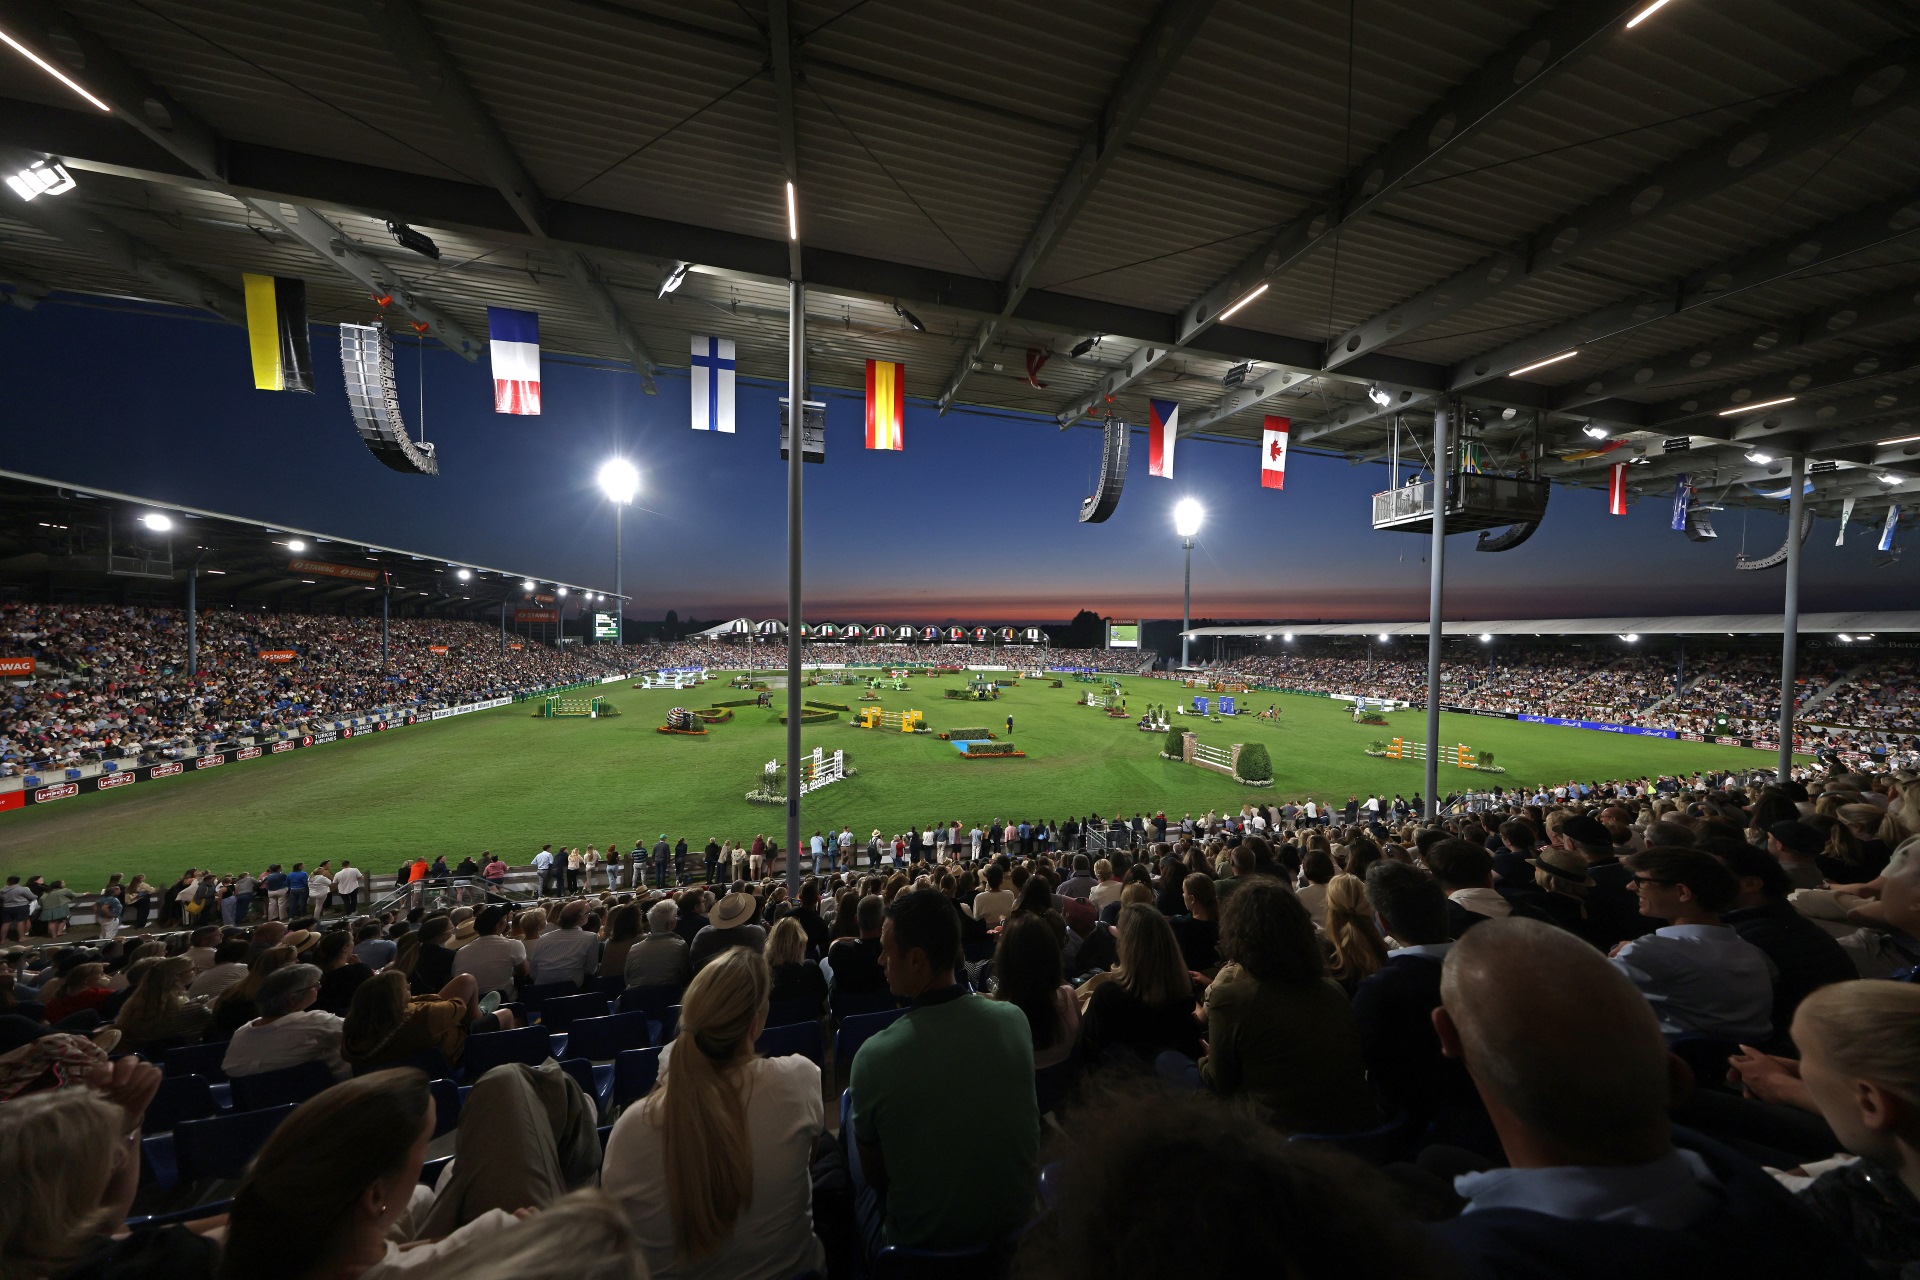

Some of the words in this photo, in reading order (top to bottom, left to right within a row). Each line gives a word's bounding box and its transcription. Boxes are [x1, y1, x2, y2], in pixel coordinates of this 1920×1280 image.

[304, 563, 335, 573] STAWAG
[349, 570, 376, 579] STAWAG
[0, 662, 30, 671] WAG
